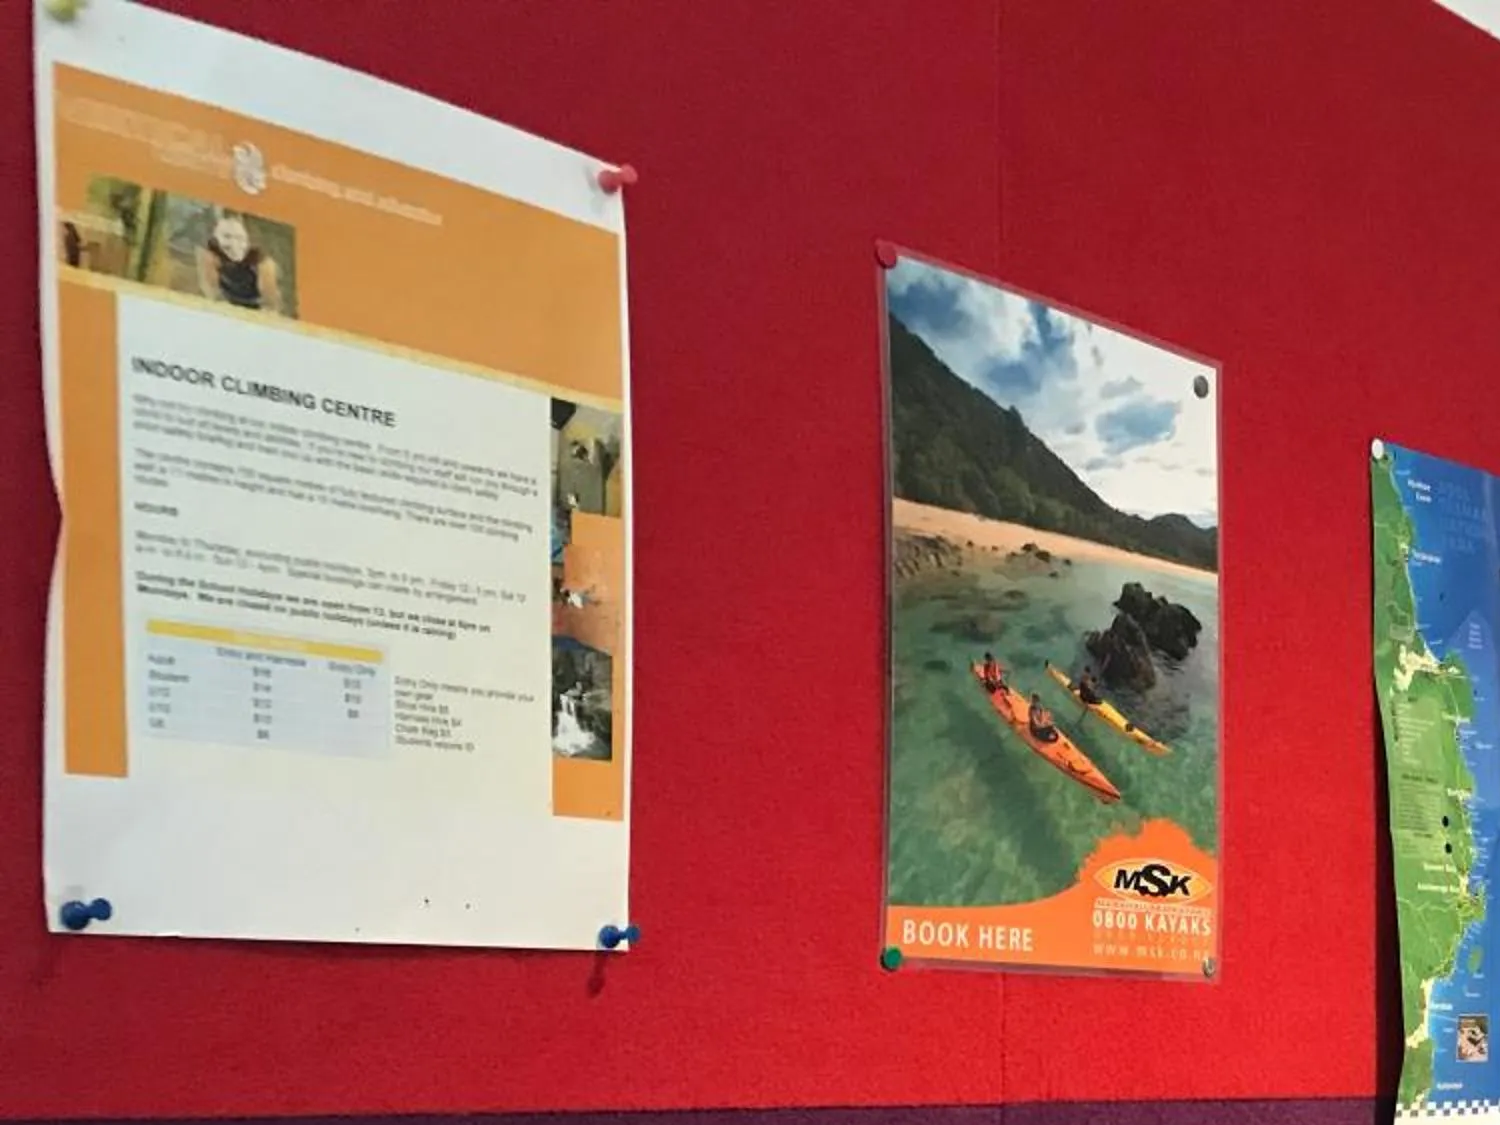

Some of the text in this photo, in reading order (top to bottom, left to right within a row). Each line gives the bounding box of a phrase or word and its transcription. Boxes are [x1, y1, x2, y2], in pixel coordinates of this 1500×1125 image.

[131, 356, 396, 428] INDOOR CLIMBING CENTRE
[1114, 863, 1192, 897] MSK
[903, 918, 1033, 952] BOOK HERE
[1093, 909, 1211, 936] 0800 KAYAKS
